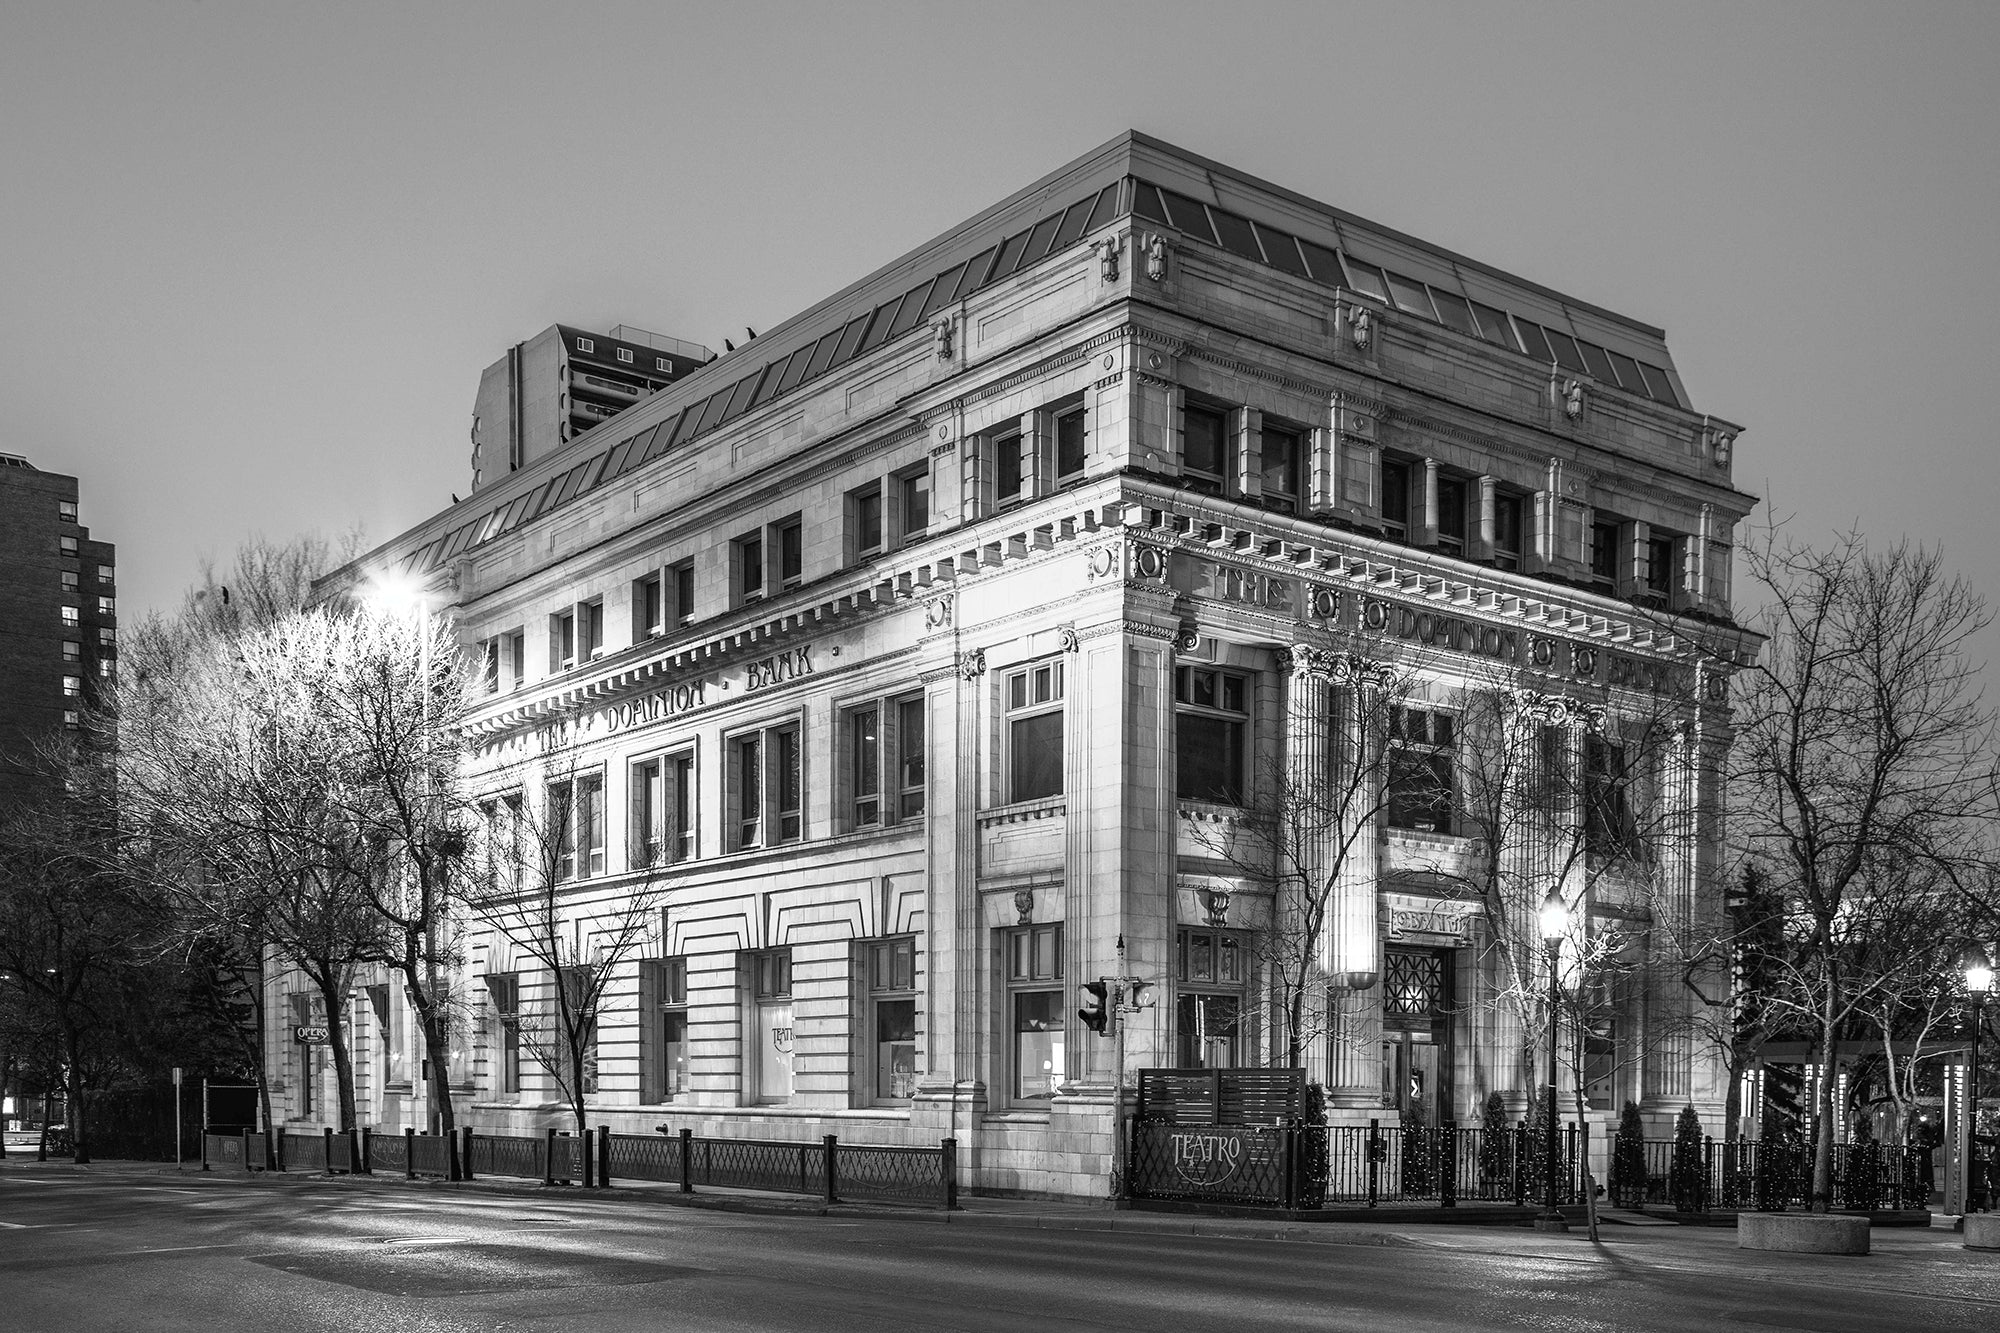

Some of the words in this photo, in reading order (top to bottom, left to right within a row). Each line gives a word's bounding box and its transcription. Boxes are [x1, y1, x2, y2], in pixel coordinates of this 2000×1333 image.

[1215, 564, 1284, 610] THE
[1399, 606, 1518, 658] DOMINION
[607, 678, 705, 733] DOMINION
[744, 644, 814, 692] BANK
[297, 1027, 329, 1038] OPERA
[772, 1027, 793, 1045] TEAT
[1171, 1133, 1241, 1168] TEATRO
